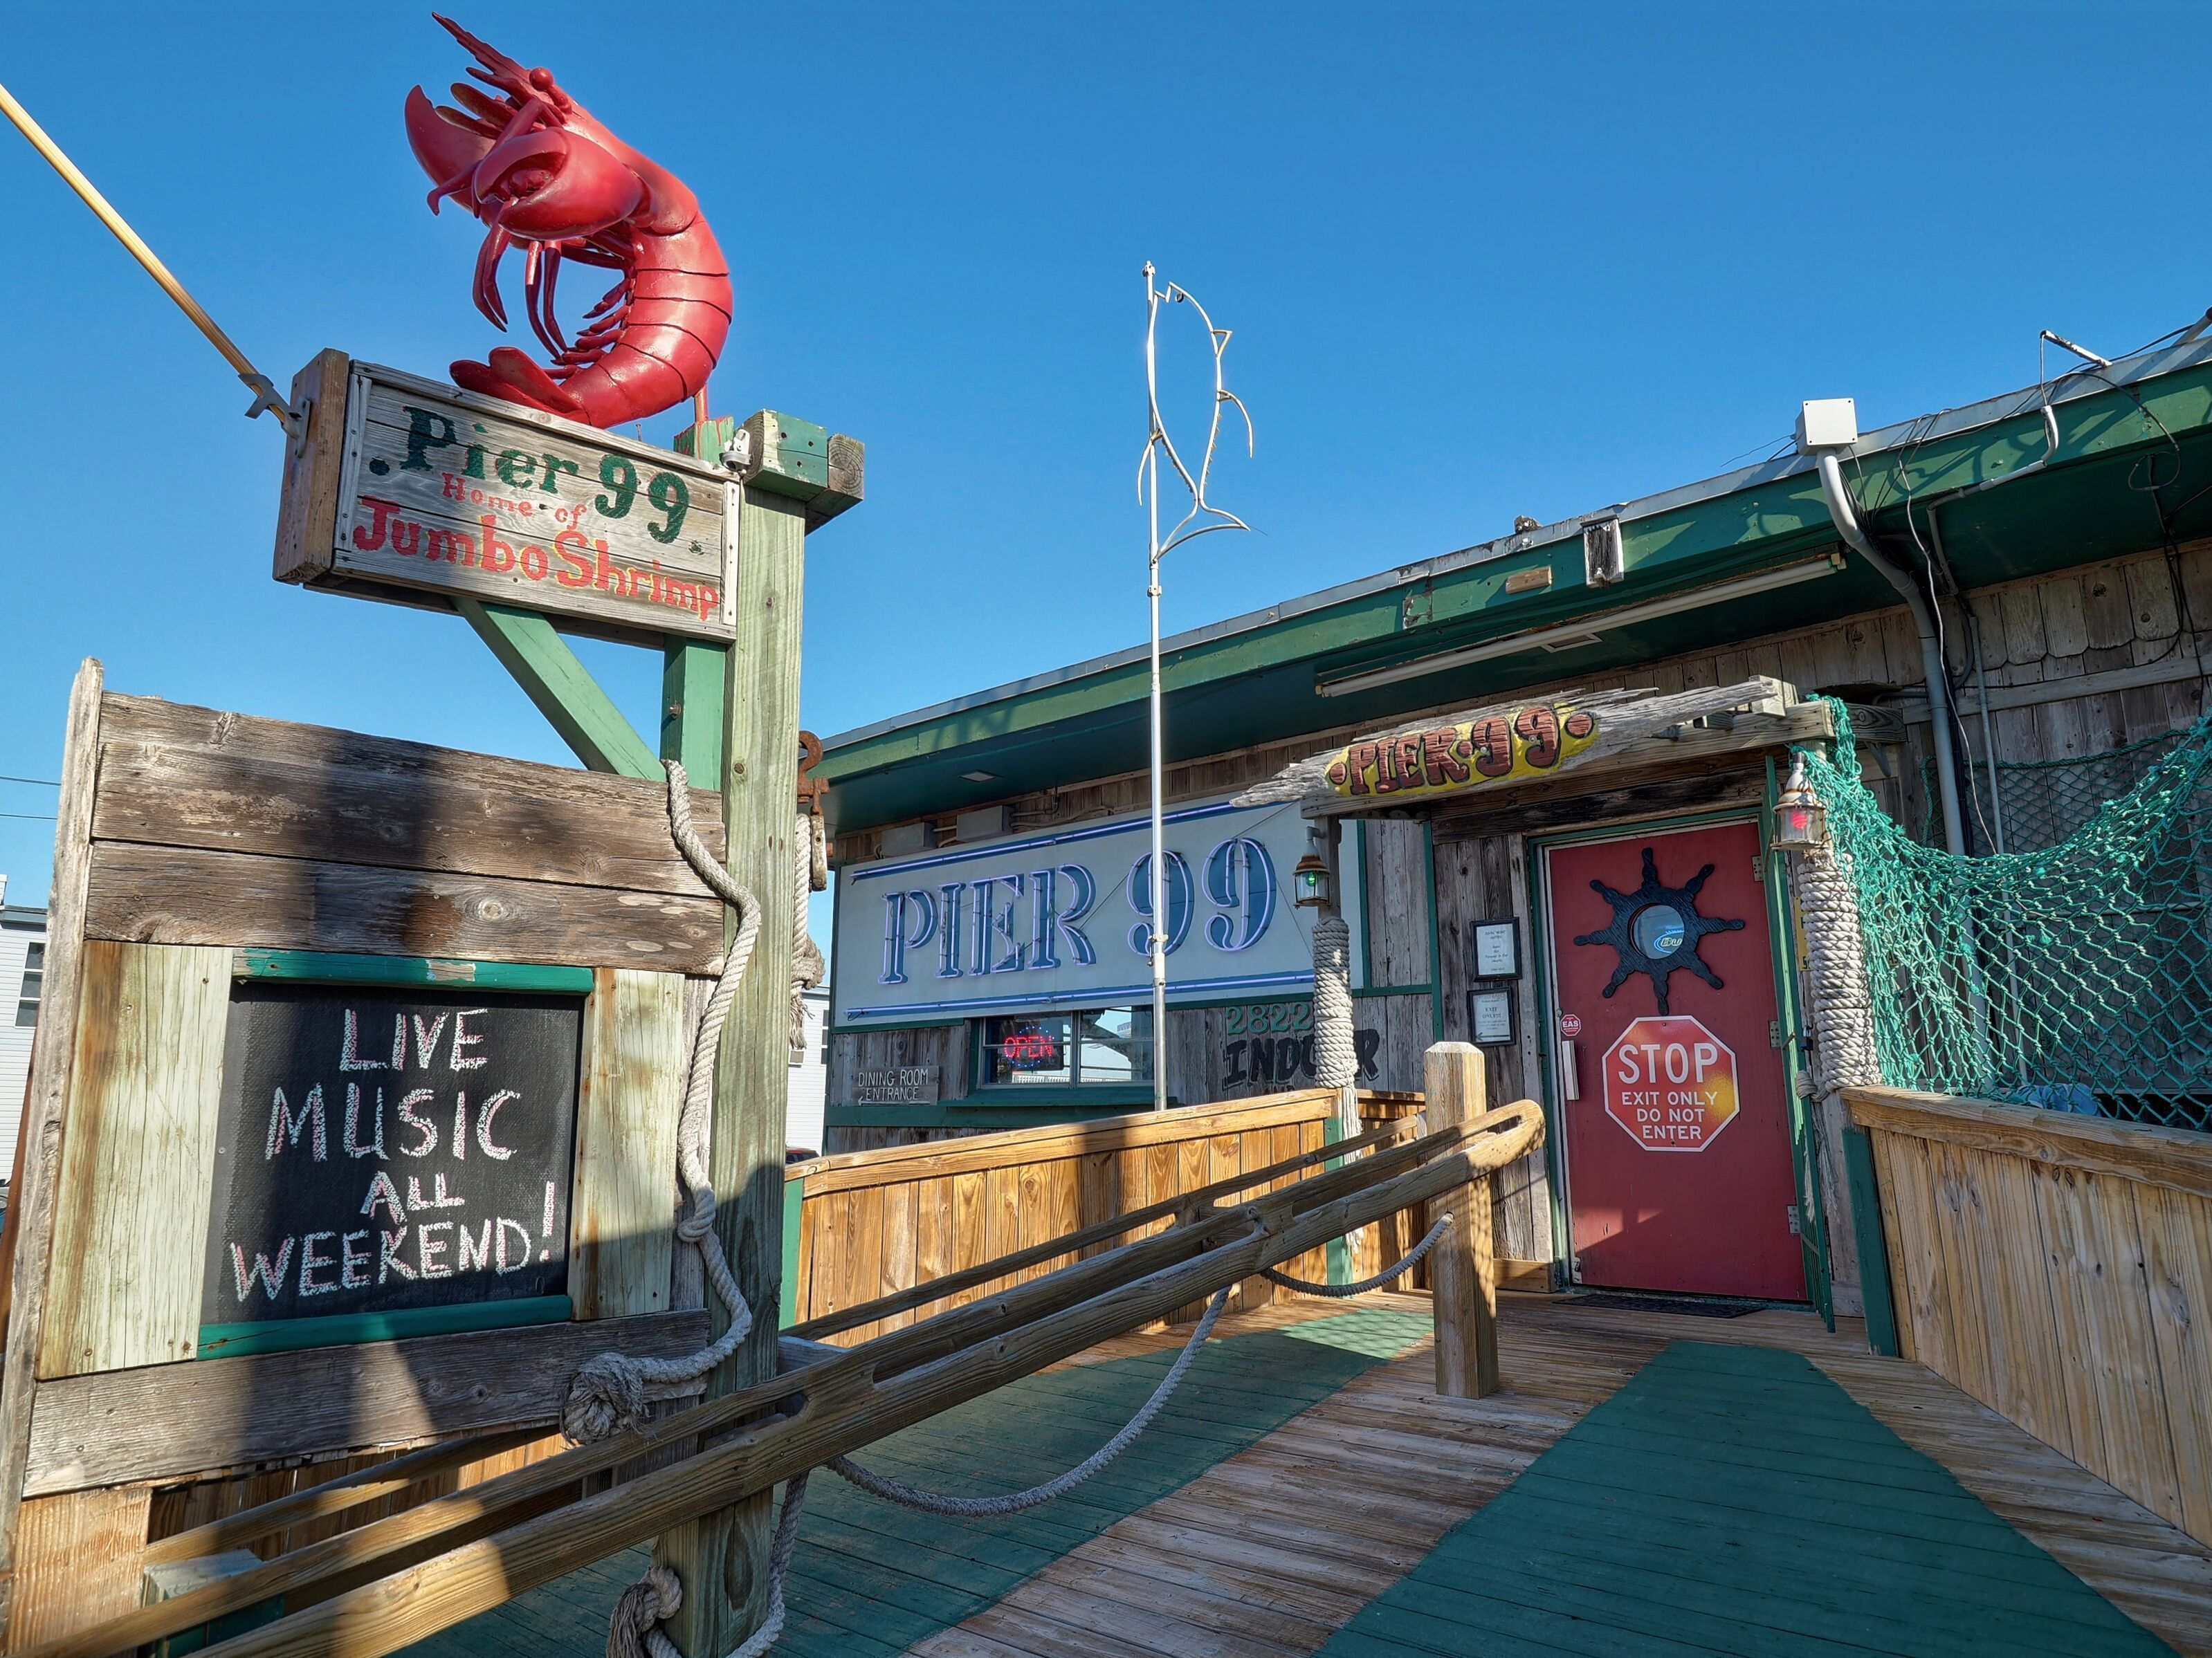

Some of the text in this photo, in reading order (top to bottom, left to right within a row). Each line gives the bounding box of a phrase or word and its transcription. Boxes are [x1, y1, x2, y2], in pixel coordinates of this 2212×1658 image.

[400, 406, 689, 544] Pier 99
[442, 472, 587, 531] Home of
[353, 495, 719, 620] Jumbo Shrimp
[1348, 706, 1561, 796] PIER 99
[877, 837, 1278, 985] PIER 99
[339, 1008, 490, 1071] LIVE
[1224, 1002, 1315, 1035] 2822
[1004, 1035, 1054, 1059] OPEN
[1222, 1028, 1380, 1091] INDR
[1618, 1042, 1718, 1084] STOP
[858, 1068, 929, 1087] DINING ROOM
[866, 1086, 919, 1101] ENTRANCE
[1621, 1091, 1719, 1105] EXIT ONLY
[265, 1083, 522, 1162] MUSIC
[1636, 1108, 1705, 1123] DO NOT
[1642, 1125, 1702, 1140] ENTER
[360, 1170, 466, 1224] ALL
[231, 1180, 556, 1302] WEEKEND!
